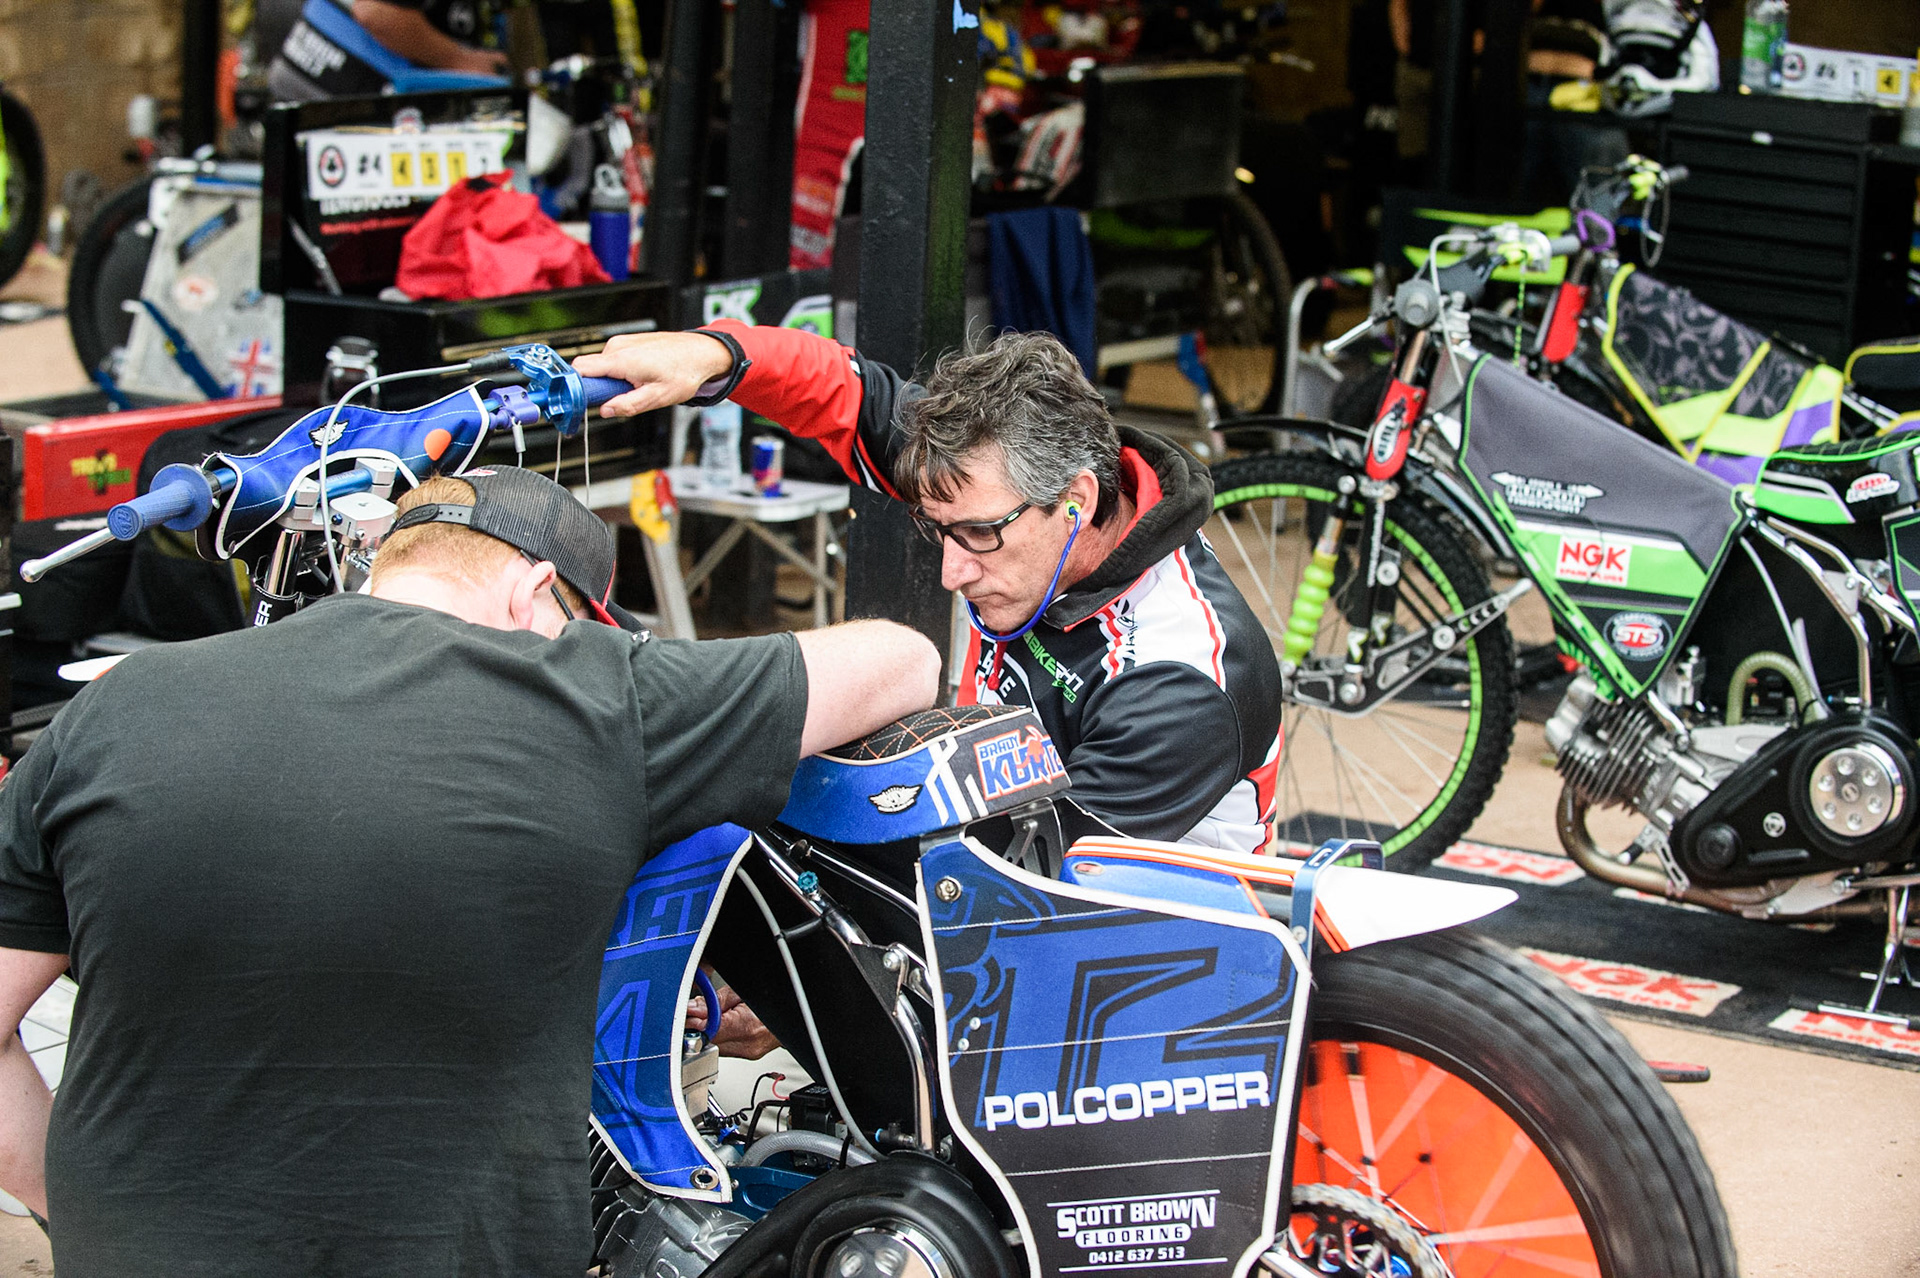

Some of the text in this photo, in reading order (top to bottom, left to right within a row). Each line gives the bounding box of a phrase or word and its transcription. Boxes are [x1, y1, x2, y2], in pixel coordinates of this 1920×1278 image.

[1561, 541, 1627, 572] NGK
[1615, 624, 1660, 645] STS
[978, 734, 1020, 759] BRADY
[984, 1070, 1271, 1132] POLCOPPER
[1056, 1196, 1217, 1239] SCOTT BROWN
[1082, 1226, 1185, 1246] FLOORING
[1088, 1245, 1186, 1265] 0412 637 513
